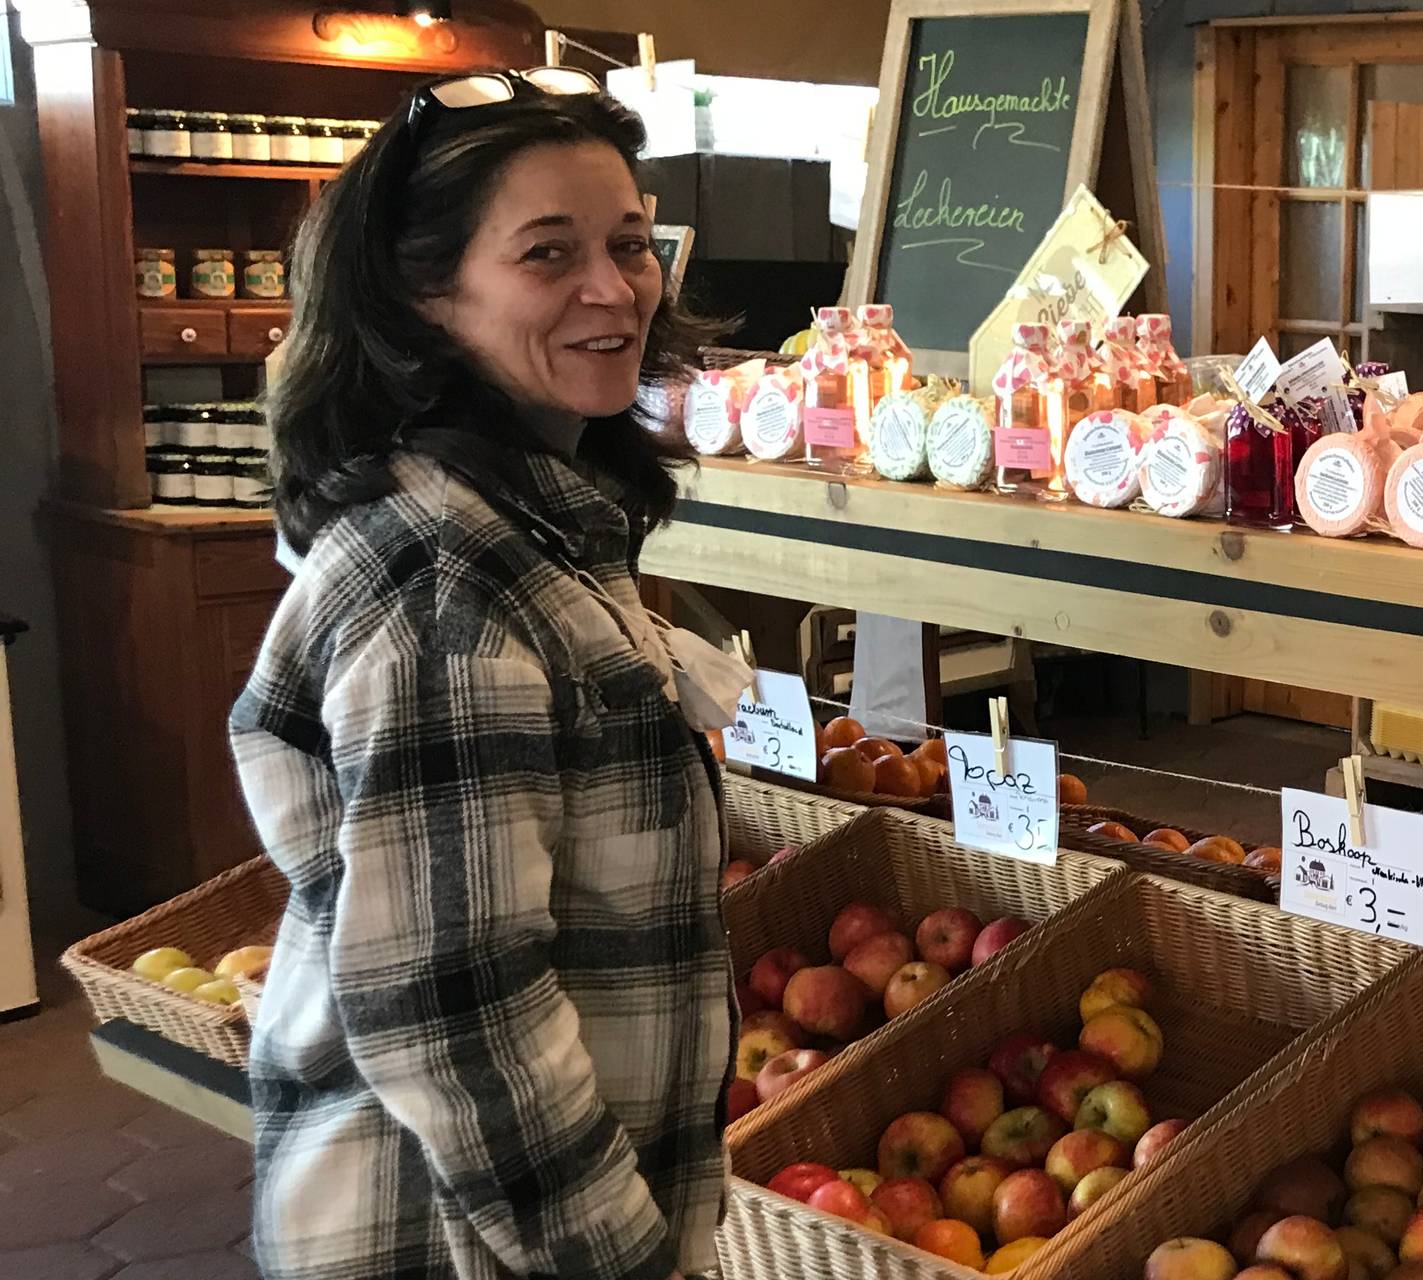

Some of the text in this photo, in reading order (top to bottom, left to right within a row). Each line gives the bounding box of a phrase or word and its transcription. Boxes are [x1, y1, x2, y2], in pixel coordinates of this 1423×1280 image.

[912, 50, 1070, 125] Hausgemachte
[894, 170, 1024, 232] Leckereien
[1292, 809, 1377, 868] Boskoop
